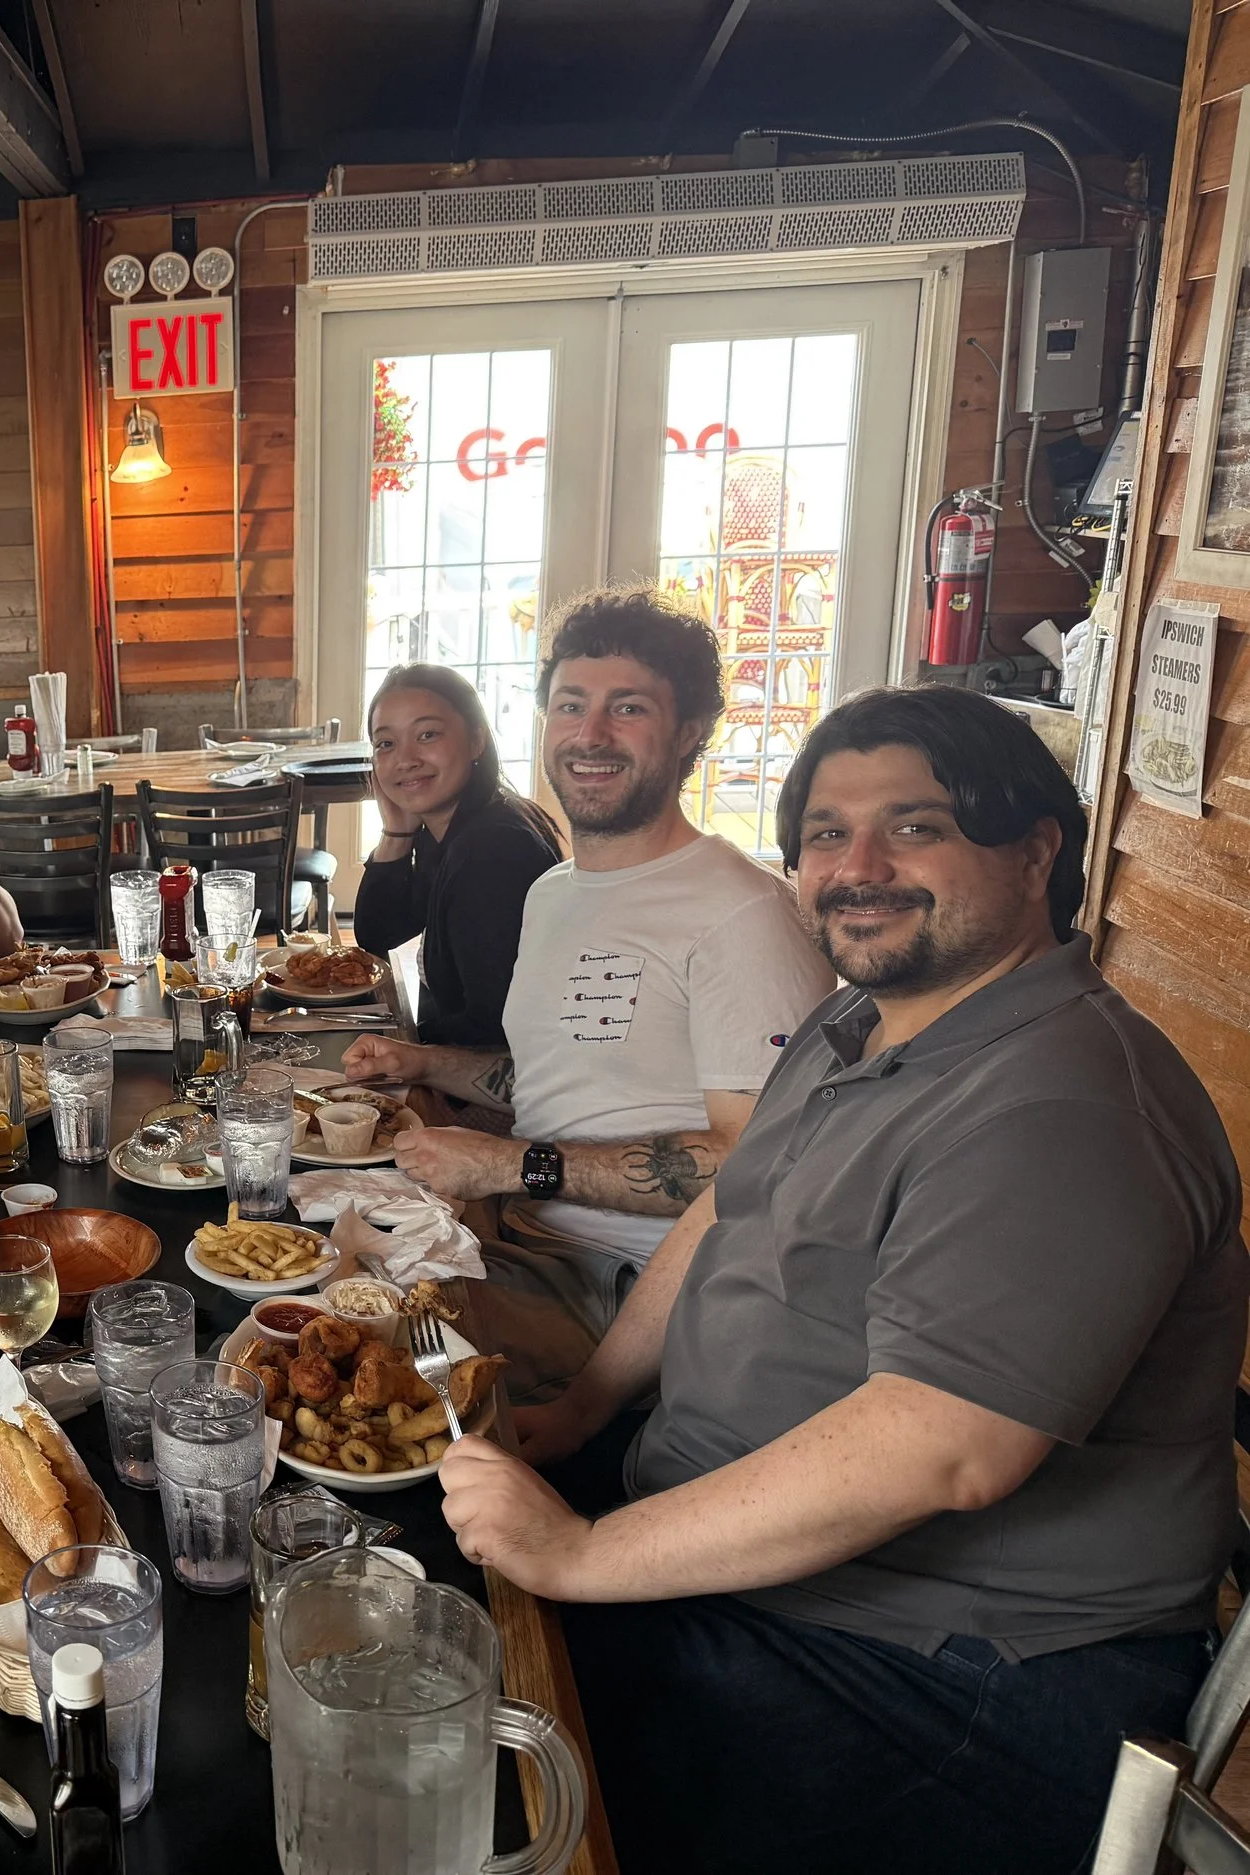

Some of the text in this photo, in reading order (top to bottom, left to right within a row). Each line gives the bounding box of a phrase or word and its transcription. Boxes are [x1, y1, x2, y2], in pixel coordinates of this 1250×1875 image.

[129, 312, 224, 392] EXIT
[1161, 619, 1205, 647] IPSWICH
[1151, 654, 1201, 684] STEAMERS
[1153, 687, 1187, 716] $25.99
[579, 954, 620, 963] Champion
[574, 993, 622, 1003] Champion
[573, 1033, 622, 1043] Champion
[527, 1173, 546, 1181] 12:29
